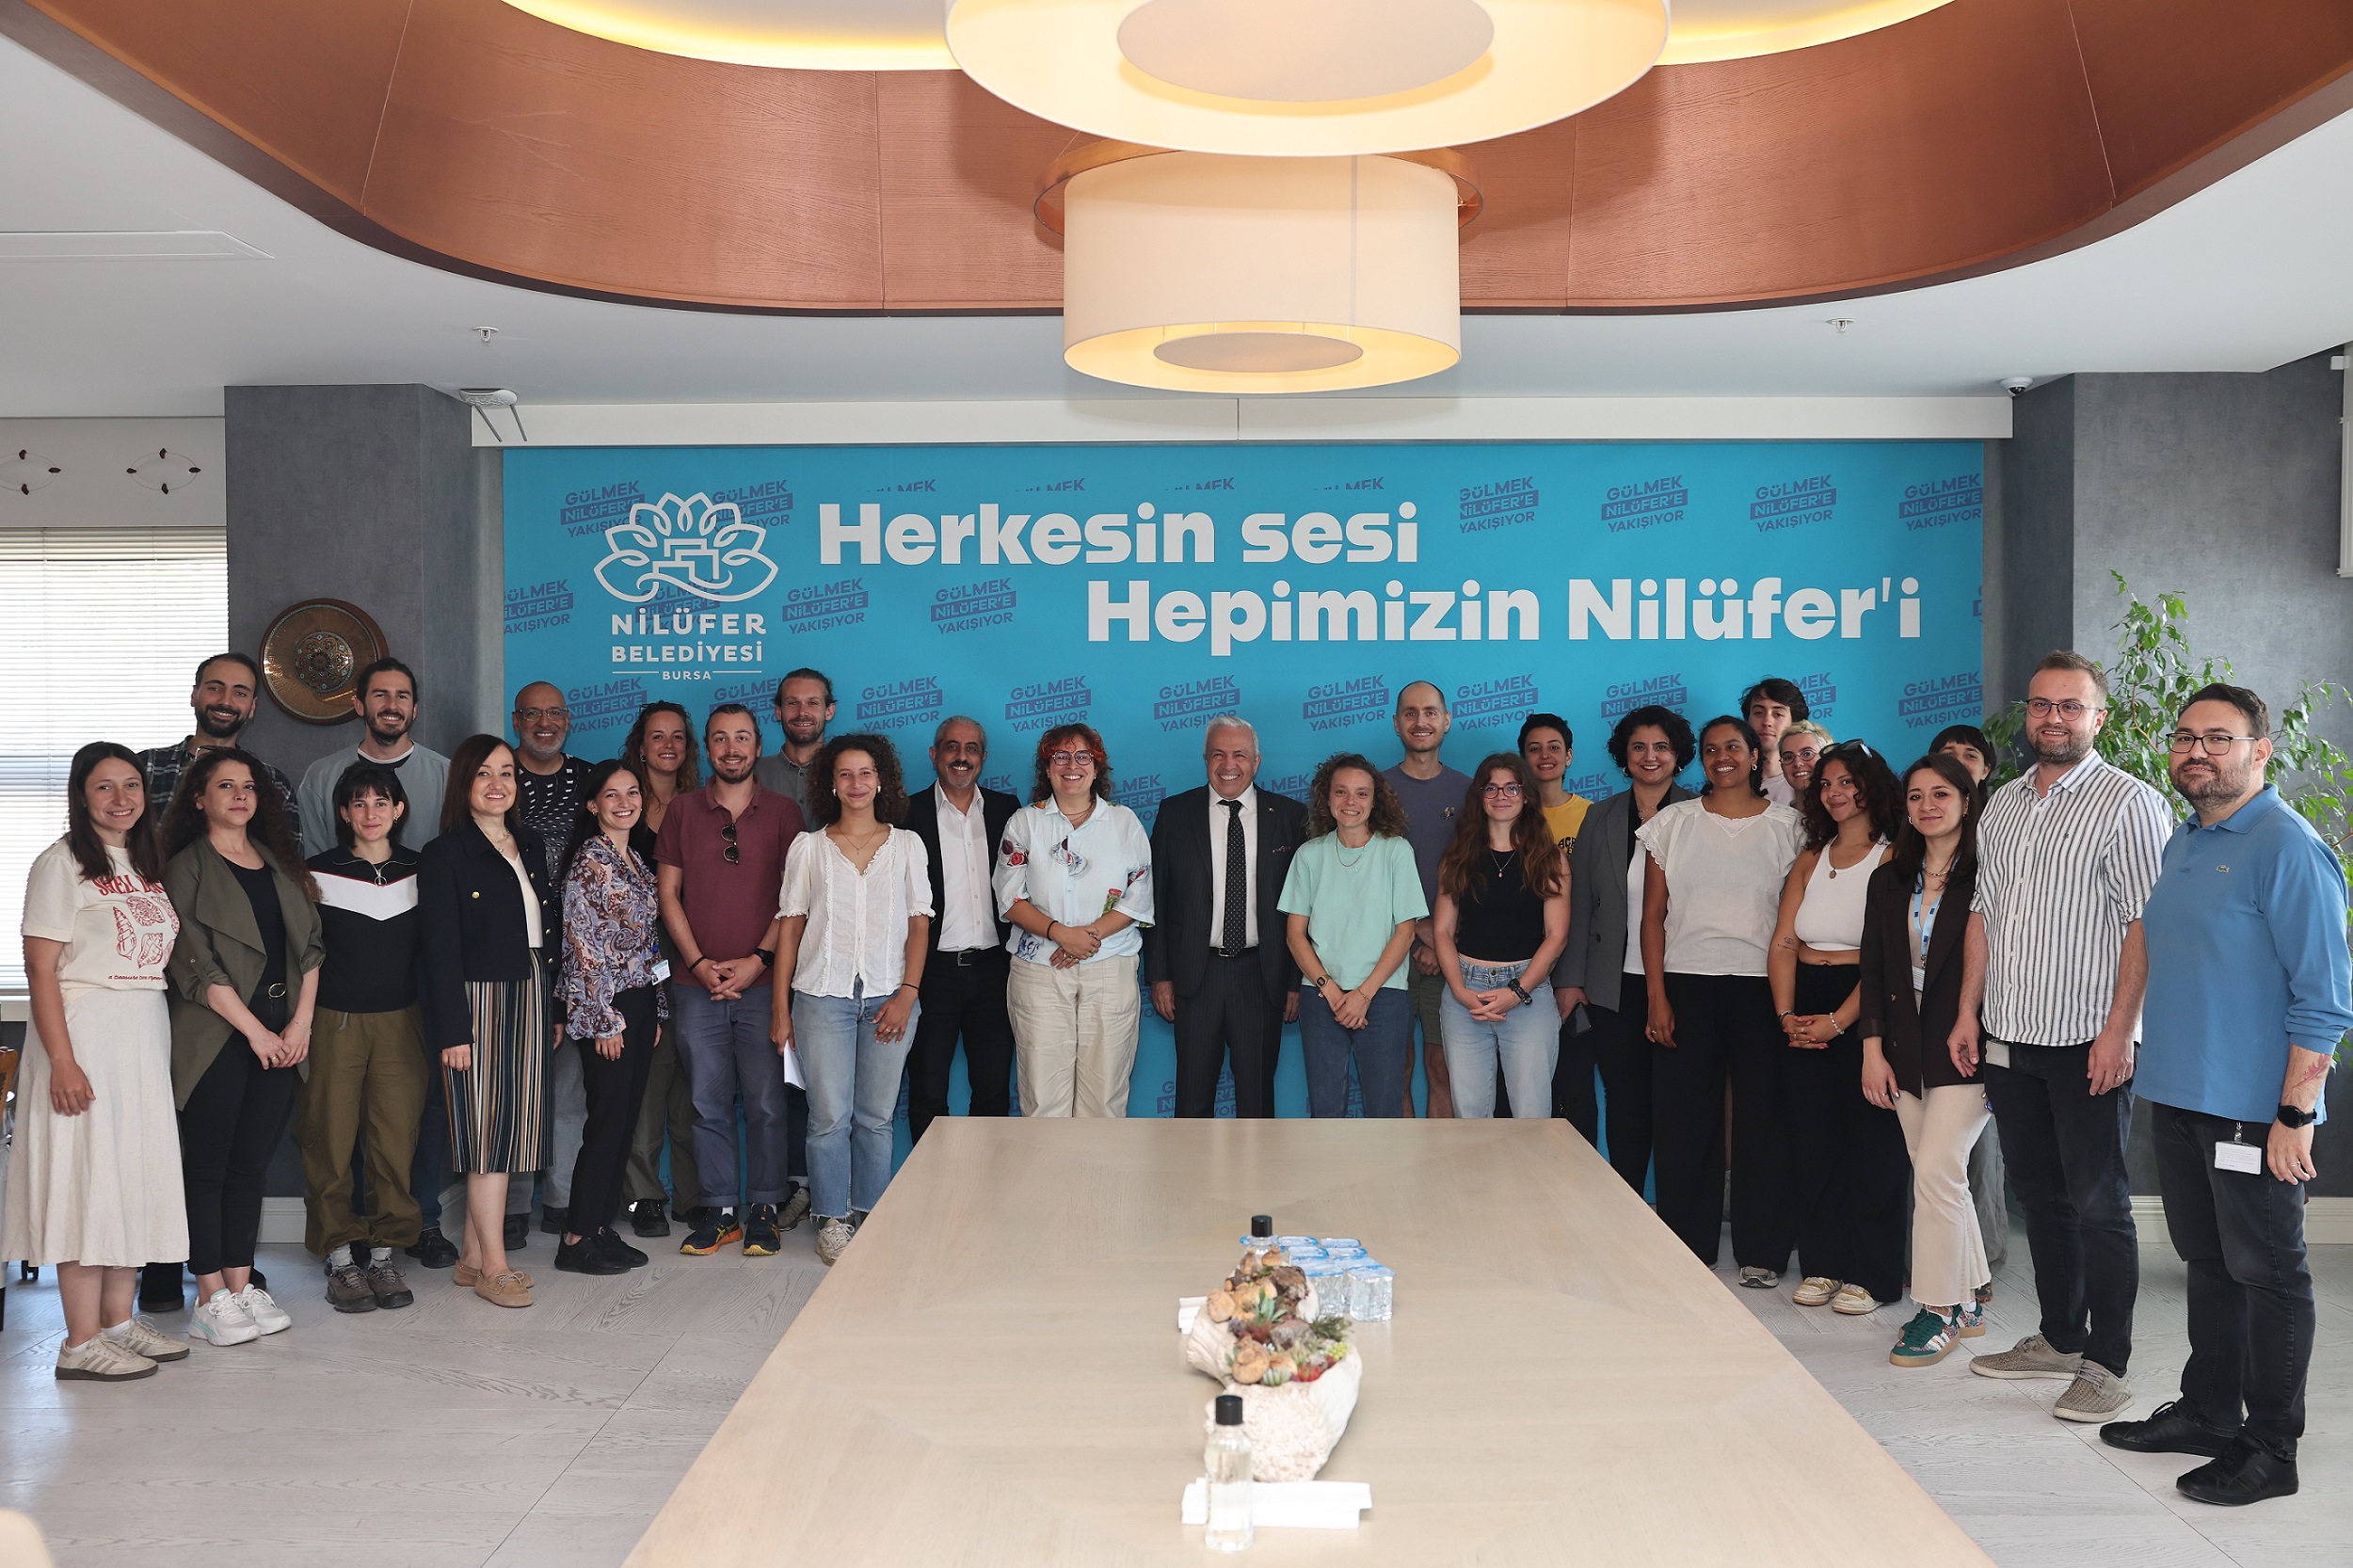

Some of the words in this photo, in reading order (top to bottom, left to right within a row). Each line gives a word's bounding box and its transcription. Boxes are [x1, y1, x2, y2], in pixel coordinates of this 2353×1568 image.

[566, 481, 639, 505] GÜLMEK
[712, 480, 787, 504] GÜLMEK
[1607, 475, 1683, 501] GÜLMEK
[1755, 474, 1832, 500] GÜLMEK
[1904, 473, 1980, 499] GÜLMEK
[1460, 511, 1535, 534] YAKIŞIYOR
[1608, 510, 1684, 533] YAKIŞIYOR
[1756, 510, 1833, 532] YAKIŞIYOR
[1905, 508, 1981, 531] YAKIŞIYOR
[819, 502, 1215, 565] Herkesin
[1241, 501, 1418, 564] sesi
[787, 578, 863, 602] GÜLMEK
[936, 578, 1011, 602] GÜLMEK
[504, 614, 570, 634] AKIŞIYOR
[612, 608, 766, 635] NİLÜFER
[789, 613, 865, 634] YAKIŞIYOR
[937, 612, 1013, 634] YAKIŞIYOR
[1088, 579, 1539, 656] Hepimizin
[1568, 577, 1921, 640] Nilüfer'i
[612, 641, 762, 663] BELEDİYESİ
[663, 671, 712, 680] BURSA
[1159, 675, 1235, 699] GÜLMEK
[1308, 674, 1385, 699] GÜLMEK
[1457, 674, 1533, 698] GÜLMEK
[1606, 673, 1682, 698] GÜLMEK
[1792, 672, 1832, 689] MEK
[1904, 671, 1980, 696] GÜLMEK
[568, 677, 642, 701] GÜLMEK
[861, 676, 937, 700] GÜLMEK
[1010, 676, 1086, 700] GÜLMEK
[862, 711, 939, 732] YAKIŞIYOR
[1012, 711, 1088, 732] YAKIŞIYOR
[1309, 710, 1385, 731] YAKIŞIYOR
[1906, 707, 1982, 729] YAKIŞIYOR
